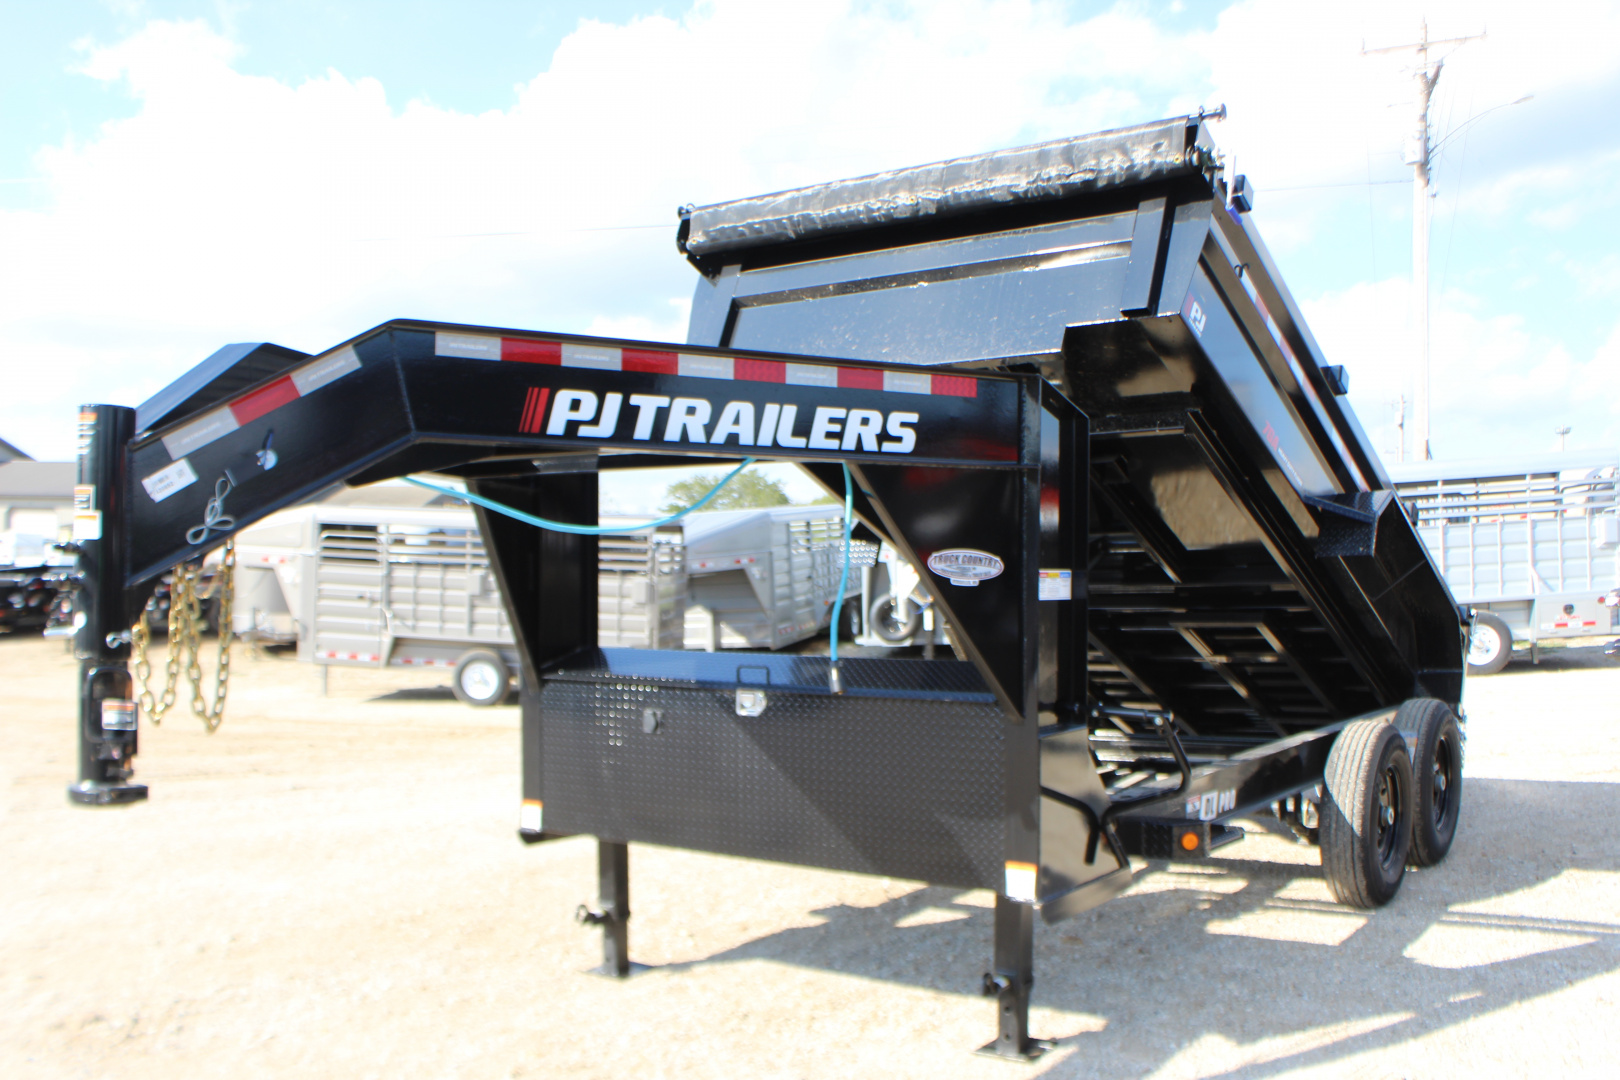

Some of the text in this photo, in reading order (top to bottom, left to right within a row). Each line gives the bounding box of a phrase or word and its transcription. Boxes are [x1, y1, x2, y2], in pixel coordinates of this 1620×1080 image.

[546, 389, 920, 453] PJ TRAILERS
[933, 553, 998, 568] TRUCK COUNTRY
